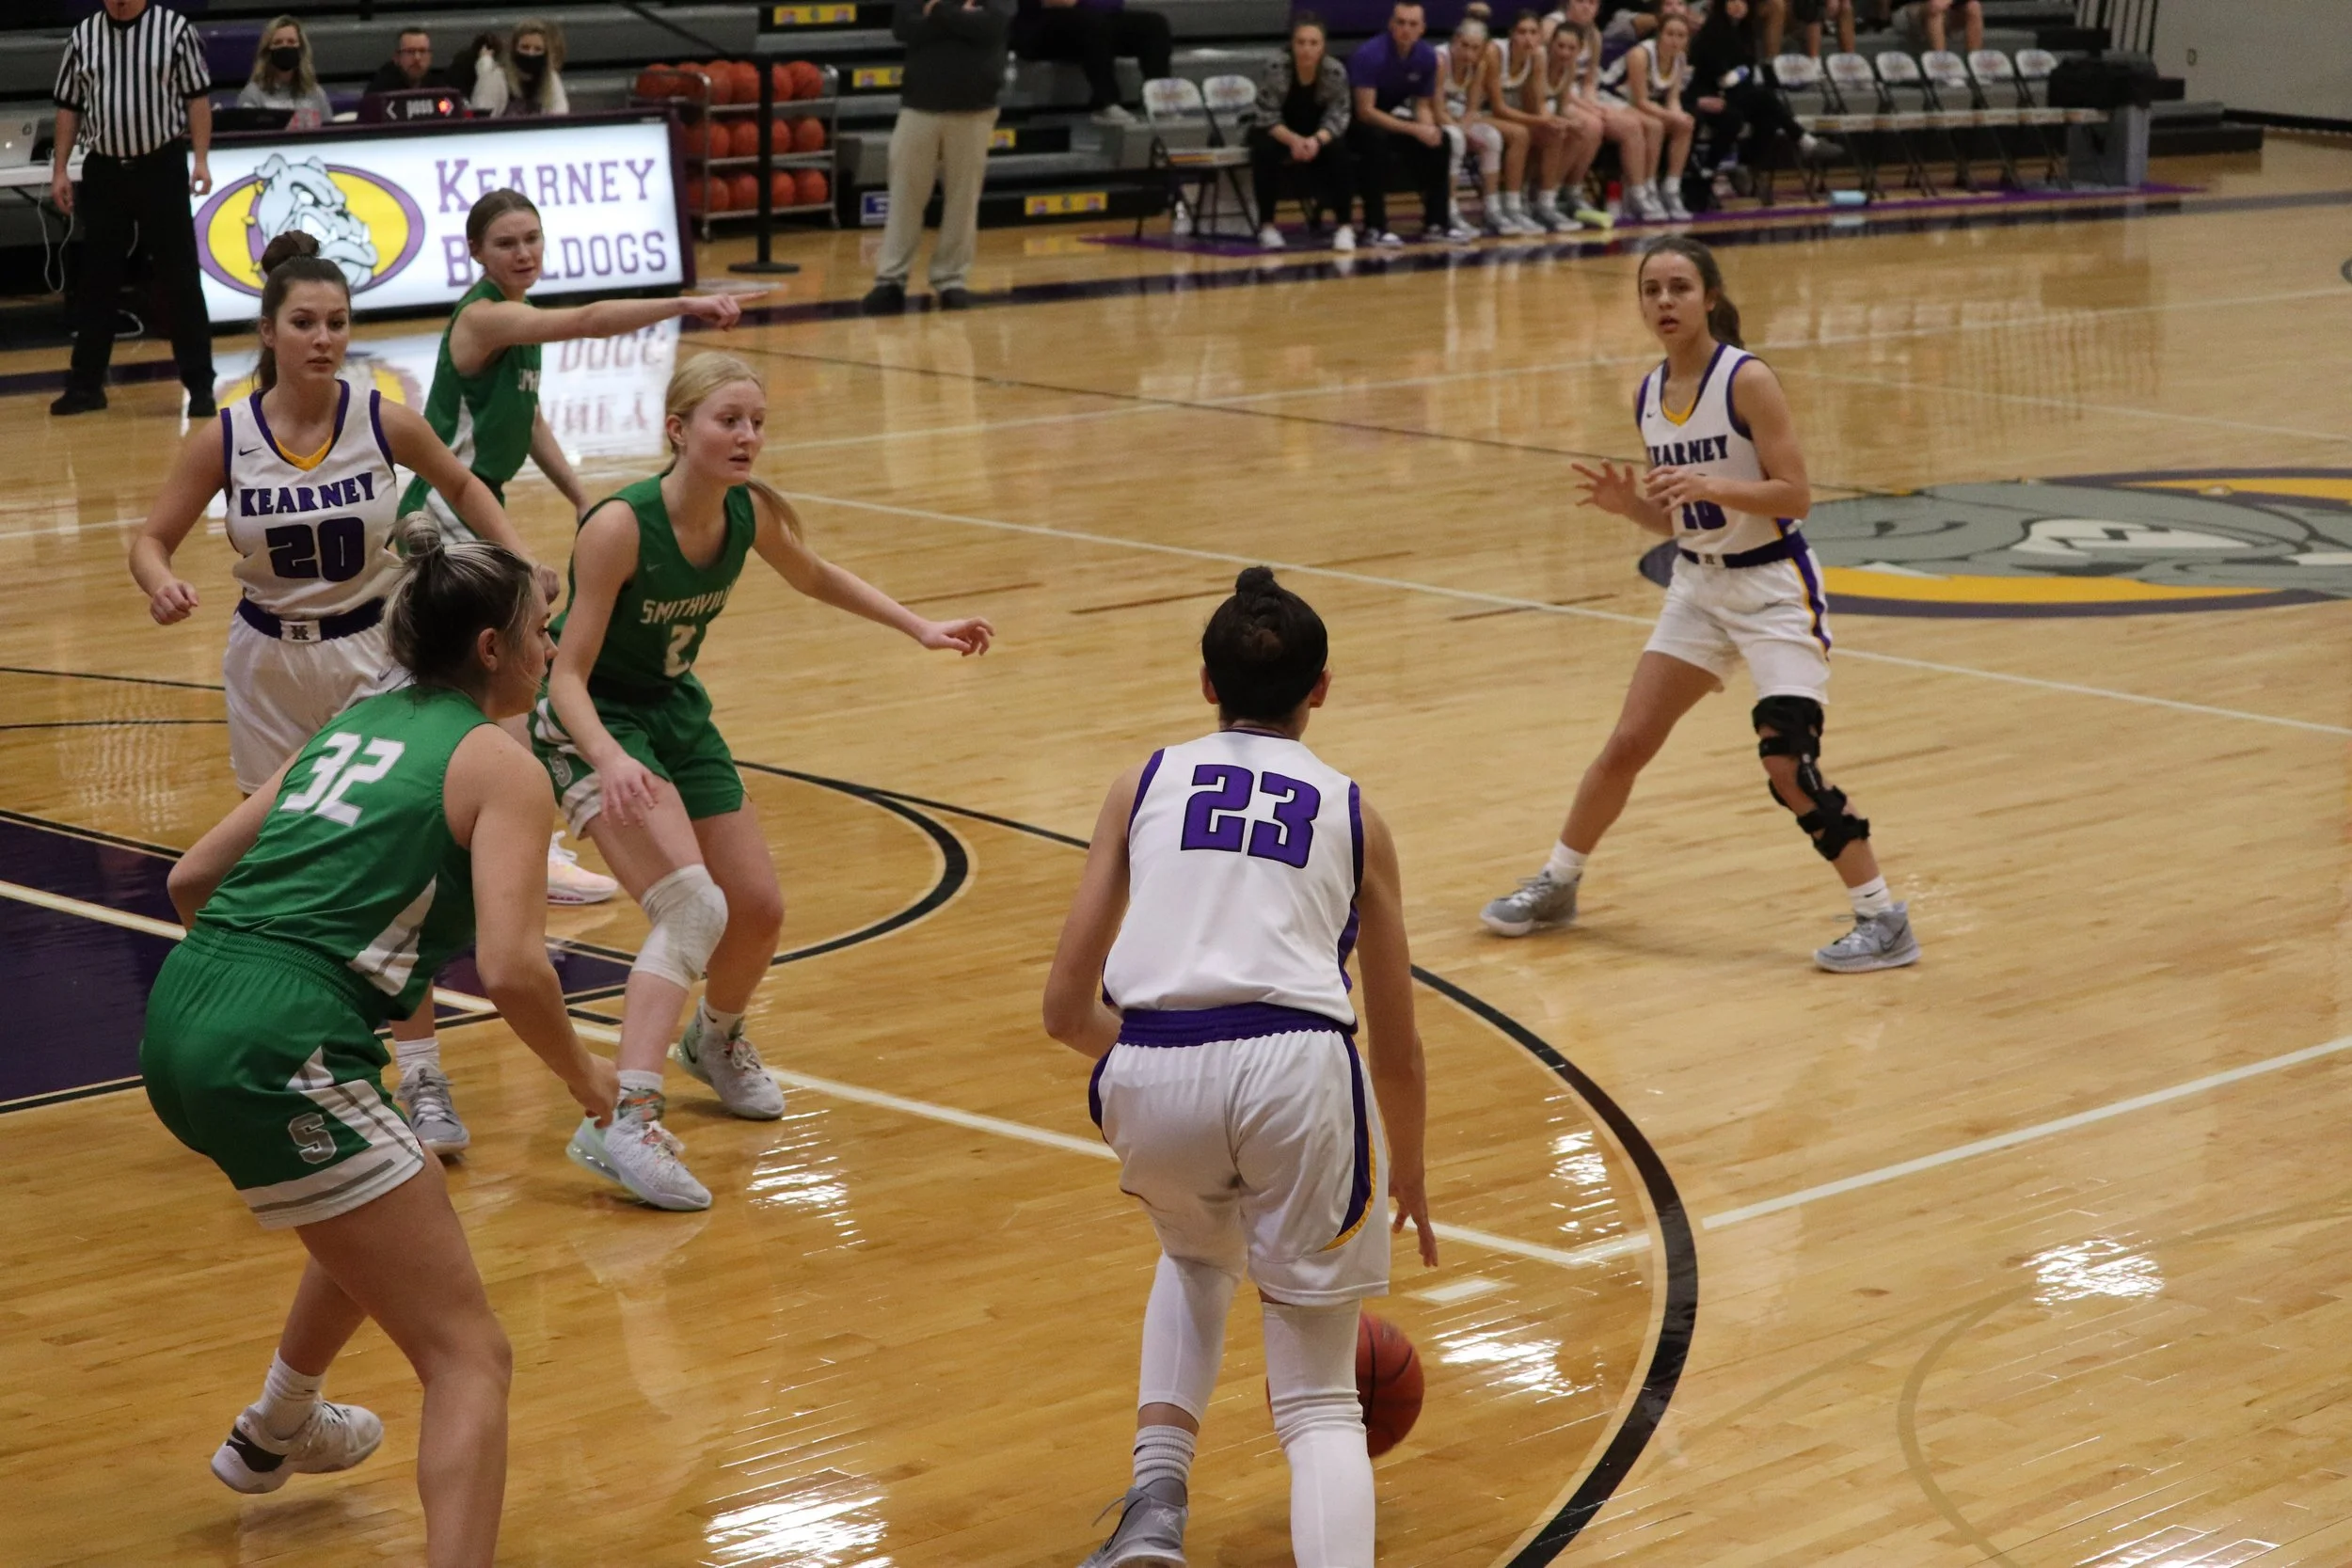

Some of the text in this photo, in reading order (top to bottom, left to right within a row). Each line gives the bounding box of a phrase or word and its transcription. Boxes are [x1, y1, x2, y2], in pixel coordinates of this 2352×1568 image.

[436, 158, 655, 213] KEARNEY
[442, 231, 666, 287] BDOGS
[241, 472, 374, 516] KEARNEY
[265, 516, 365, 582] 20
[662, 624, 696, 677] 2
[278, 731, 405, 828] 32
[1181, 764, 1322, 869] 23
[288, 1112, 338, 1164] S
